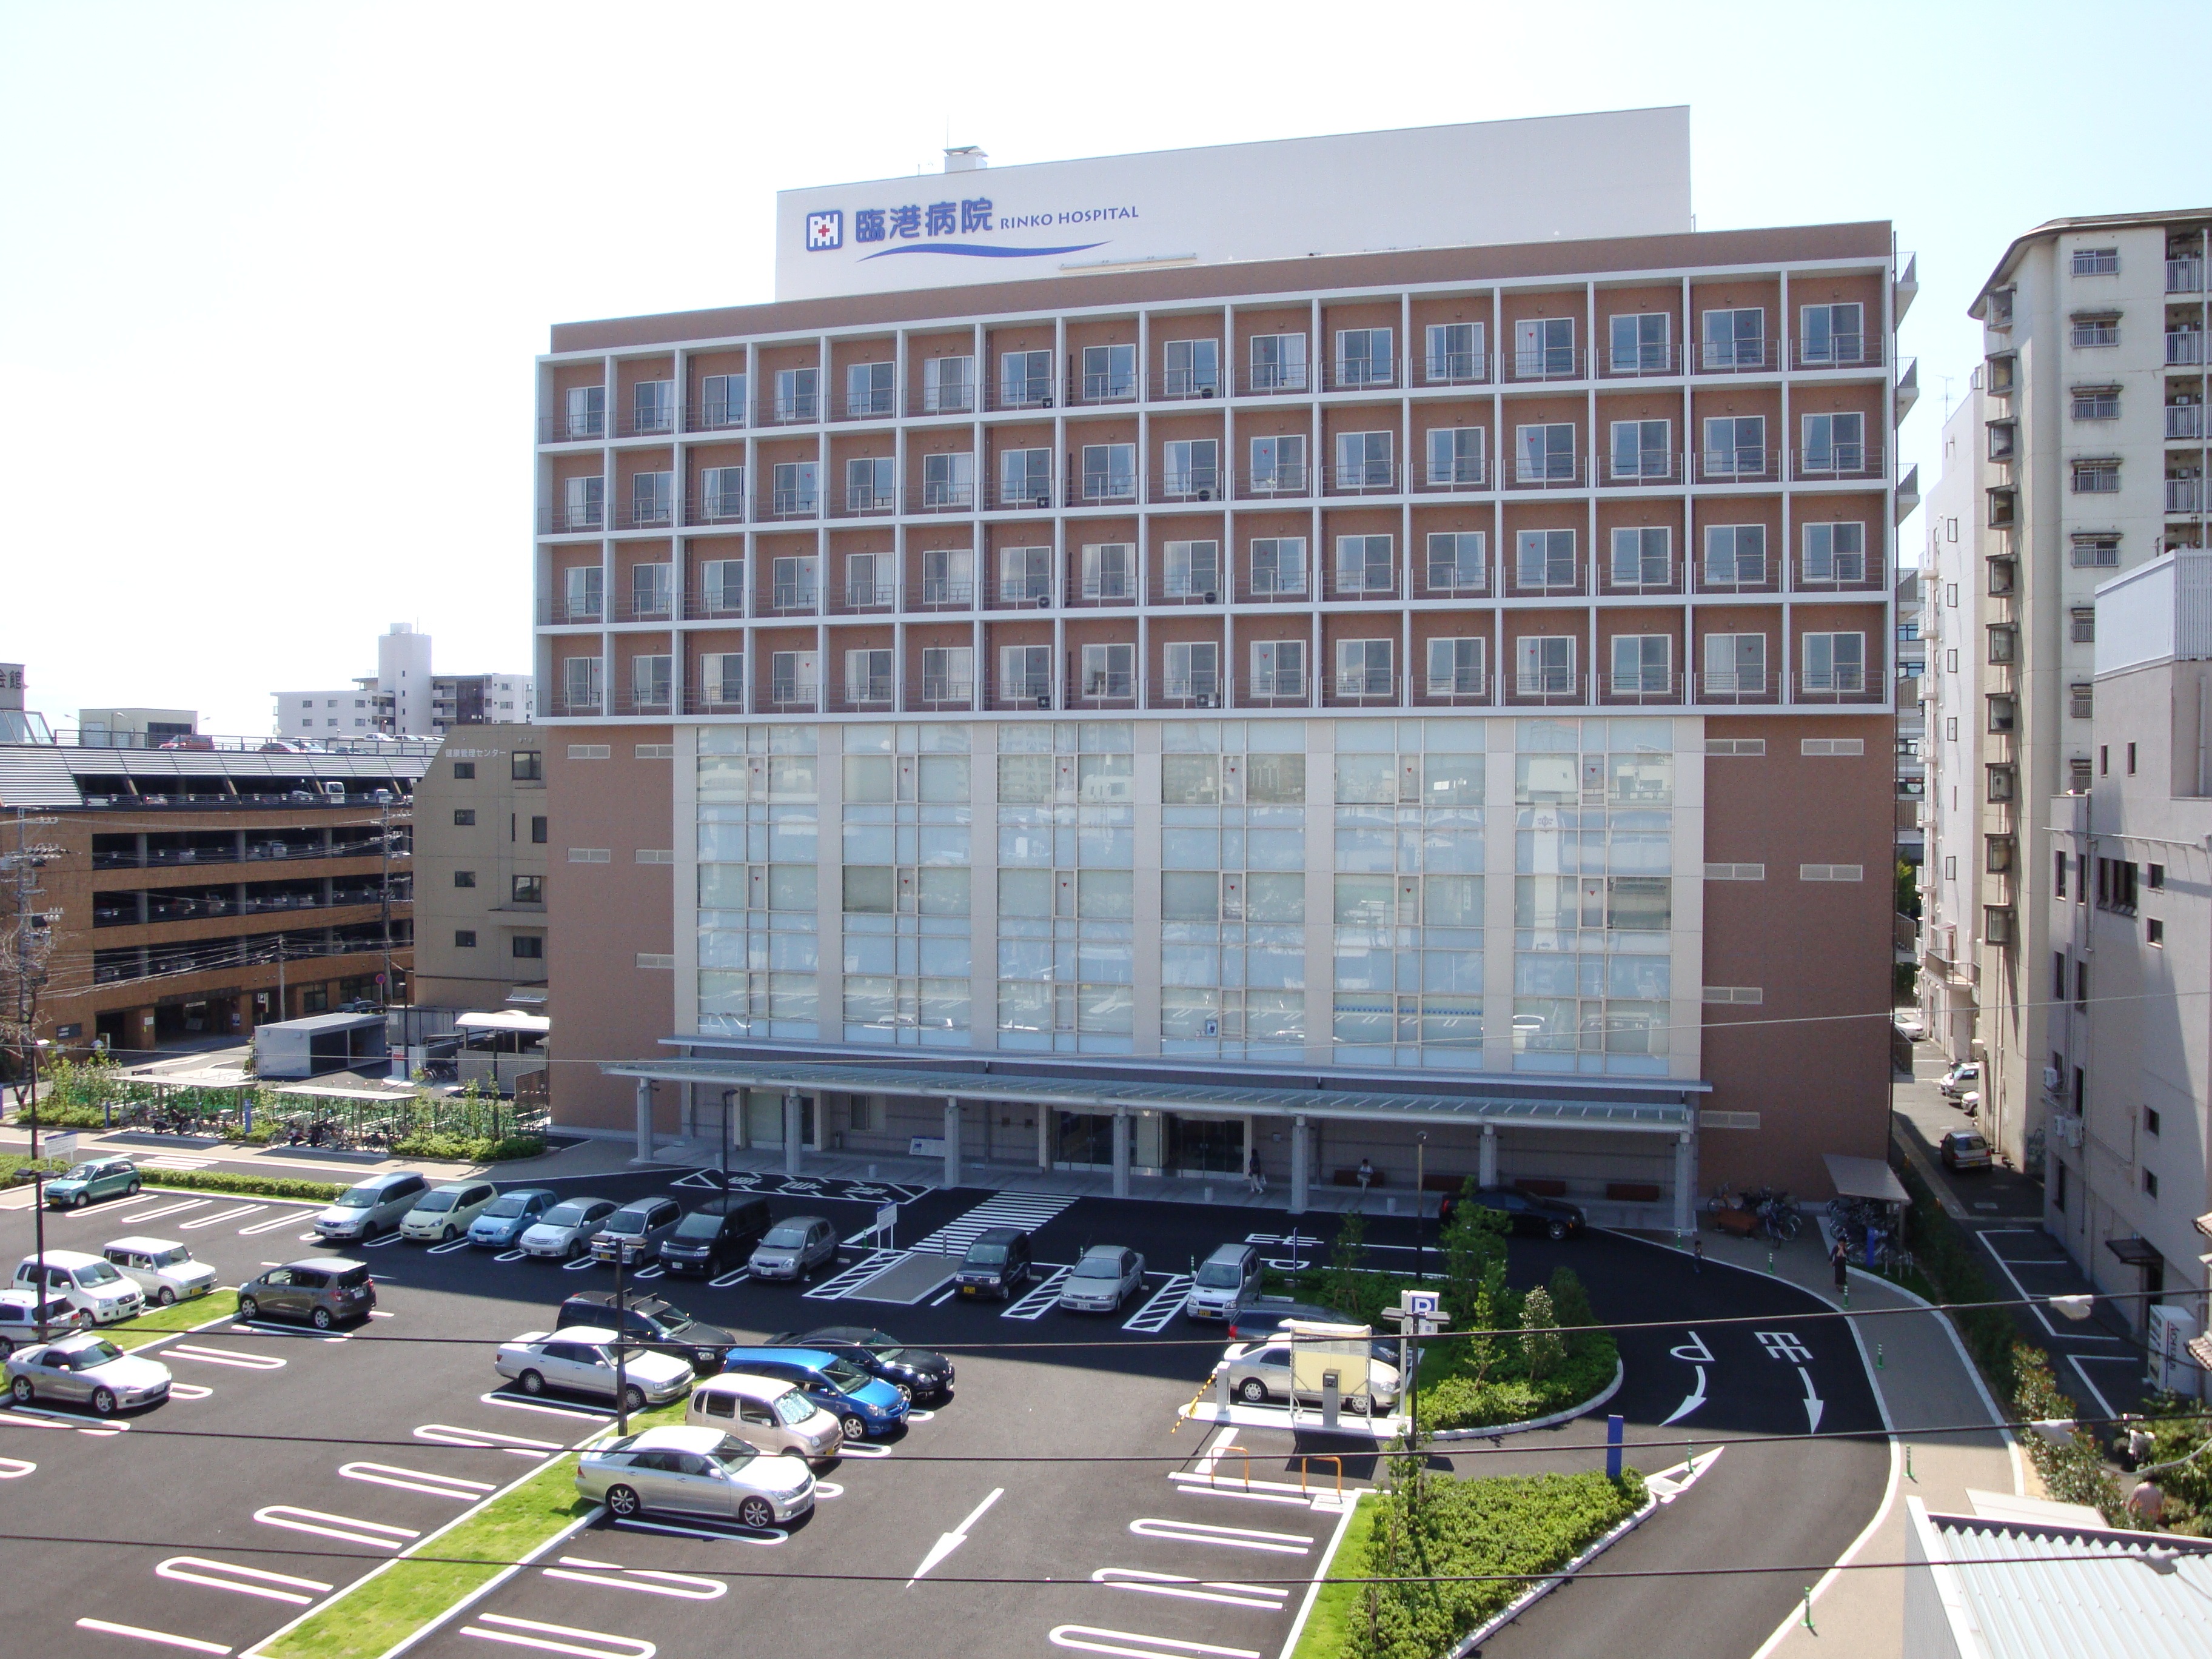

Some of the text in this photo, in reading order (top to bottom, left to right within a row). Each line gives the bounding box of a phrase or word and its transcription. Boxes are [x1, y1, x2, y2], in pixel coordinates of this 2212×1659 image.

[856, 197, 993, 243] 臨港病院
[1000, 206, 1139, 229] RINKO HOSPITAL
[1415, 1298, 1432, 1313] P
